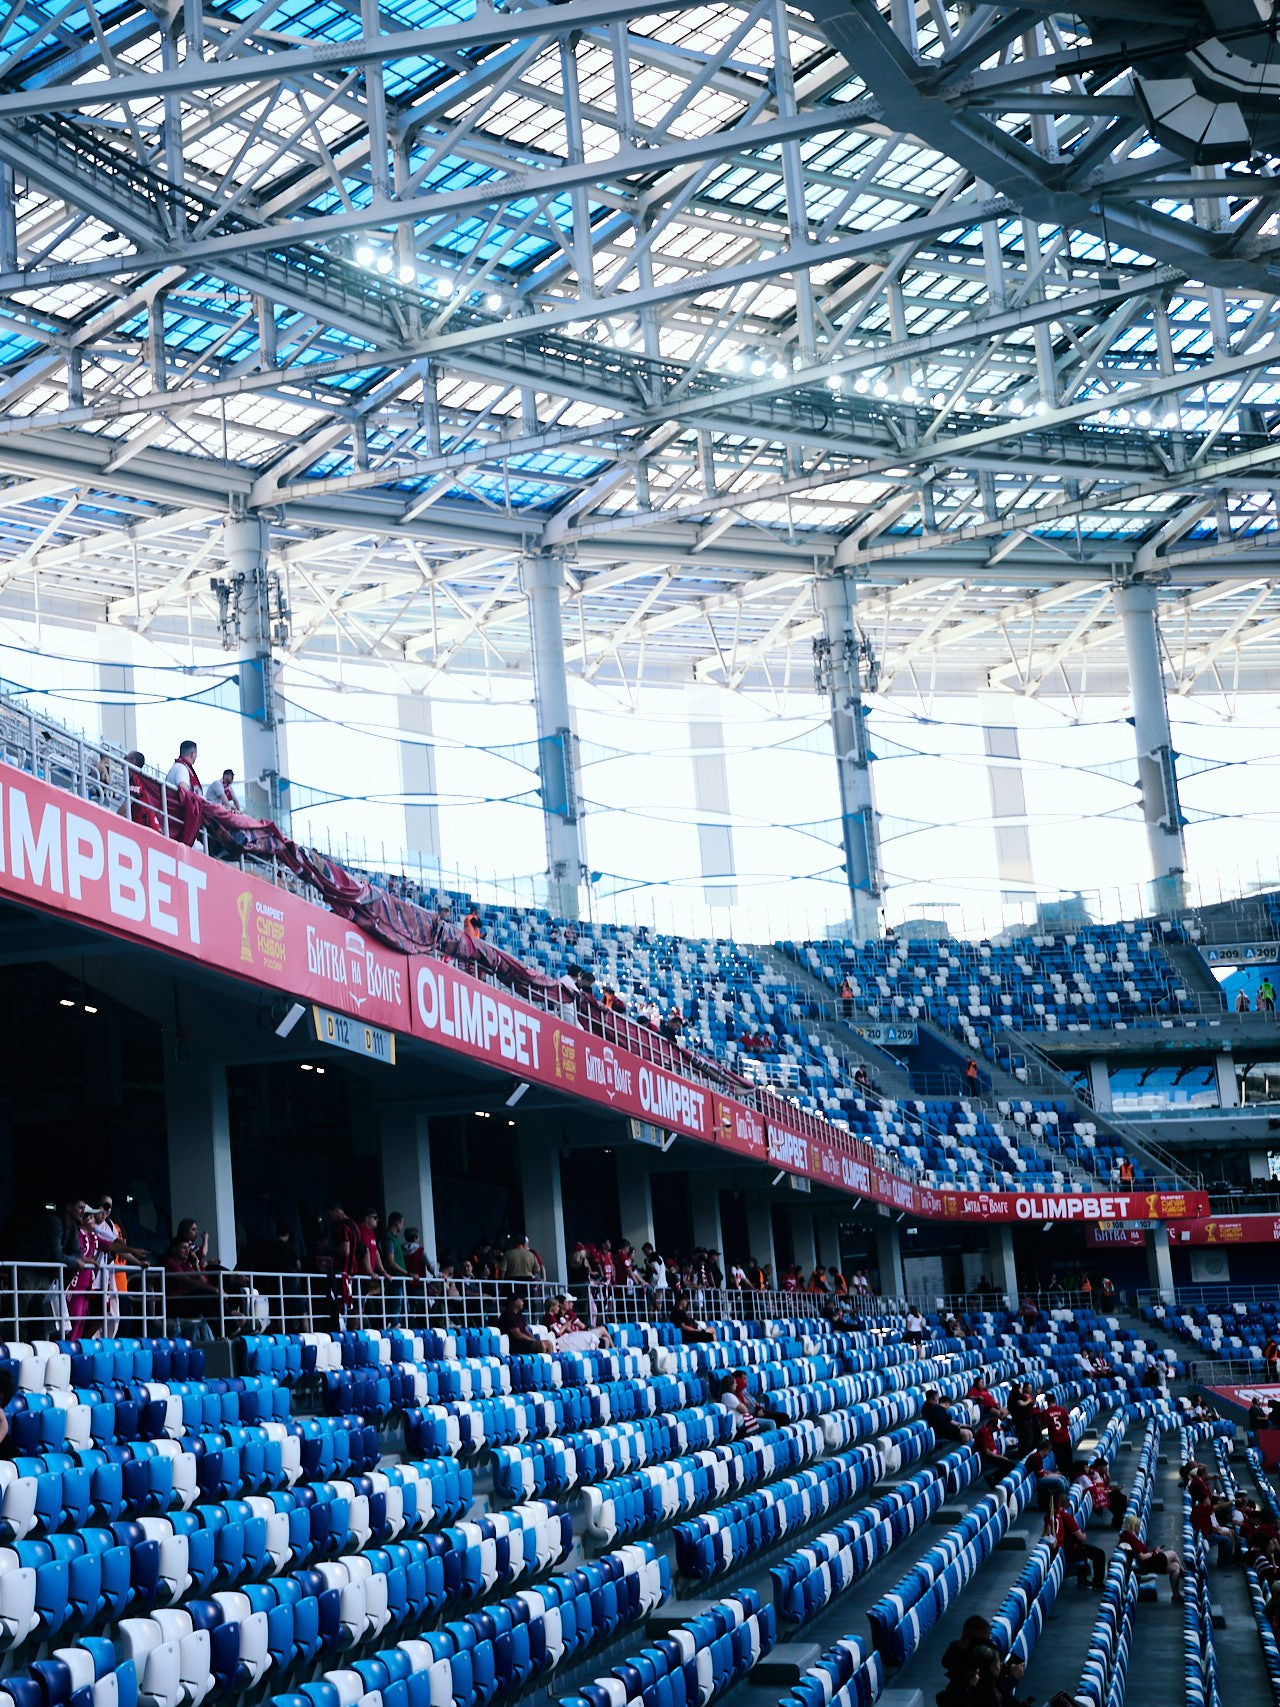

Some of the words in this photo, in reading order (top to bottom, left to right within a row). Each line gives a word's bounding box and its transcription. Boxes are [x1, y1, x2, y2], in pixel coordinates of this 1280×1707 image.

[255, 901, 283, 922] OLIMPBET
[1220, 950, 1239, 959] 209
[417, 966, 541, 1071] OLIMPBET
[336, 1018, 350, 1044] 112
[373, 1031, 384, 1056] 111
[866, 1029, 881, 1039] 210
[897, 1029, 913, 1039] 209
[638, 1066, 705, 1133] OLIMPBET
[1015, 1197, 1131, 1219] OLIMPBET
[1053, 1416, 1062, 1430] 5
